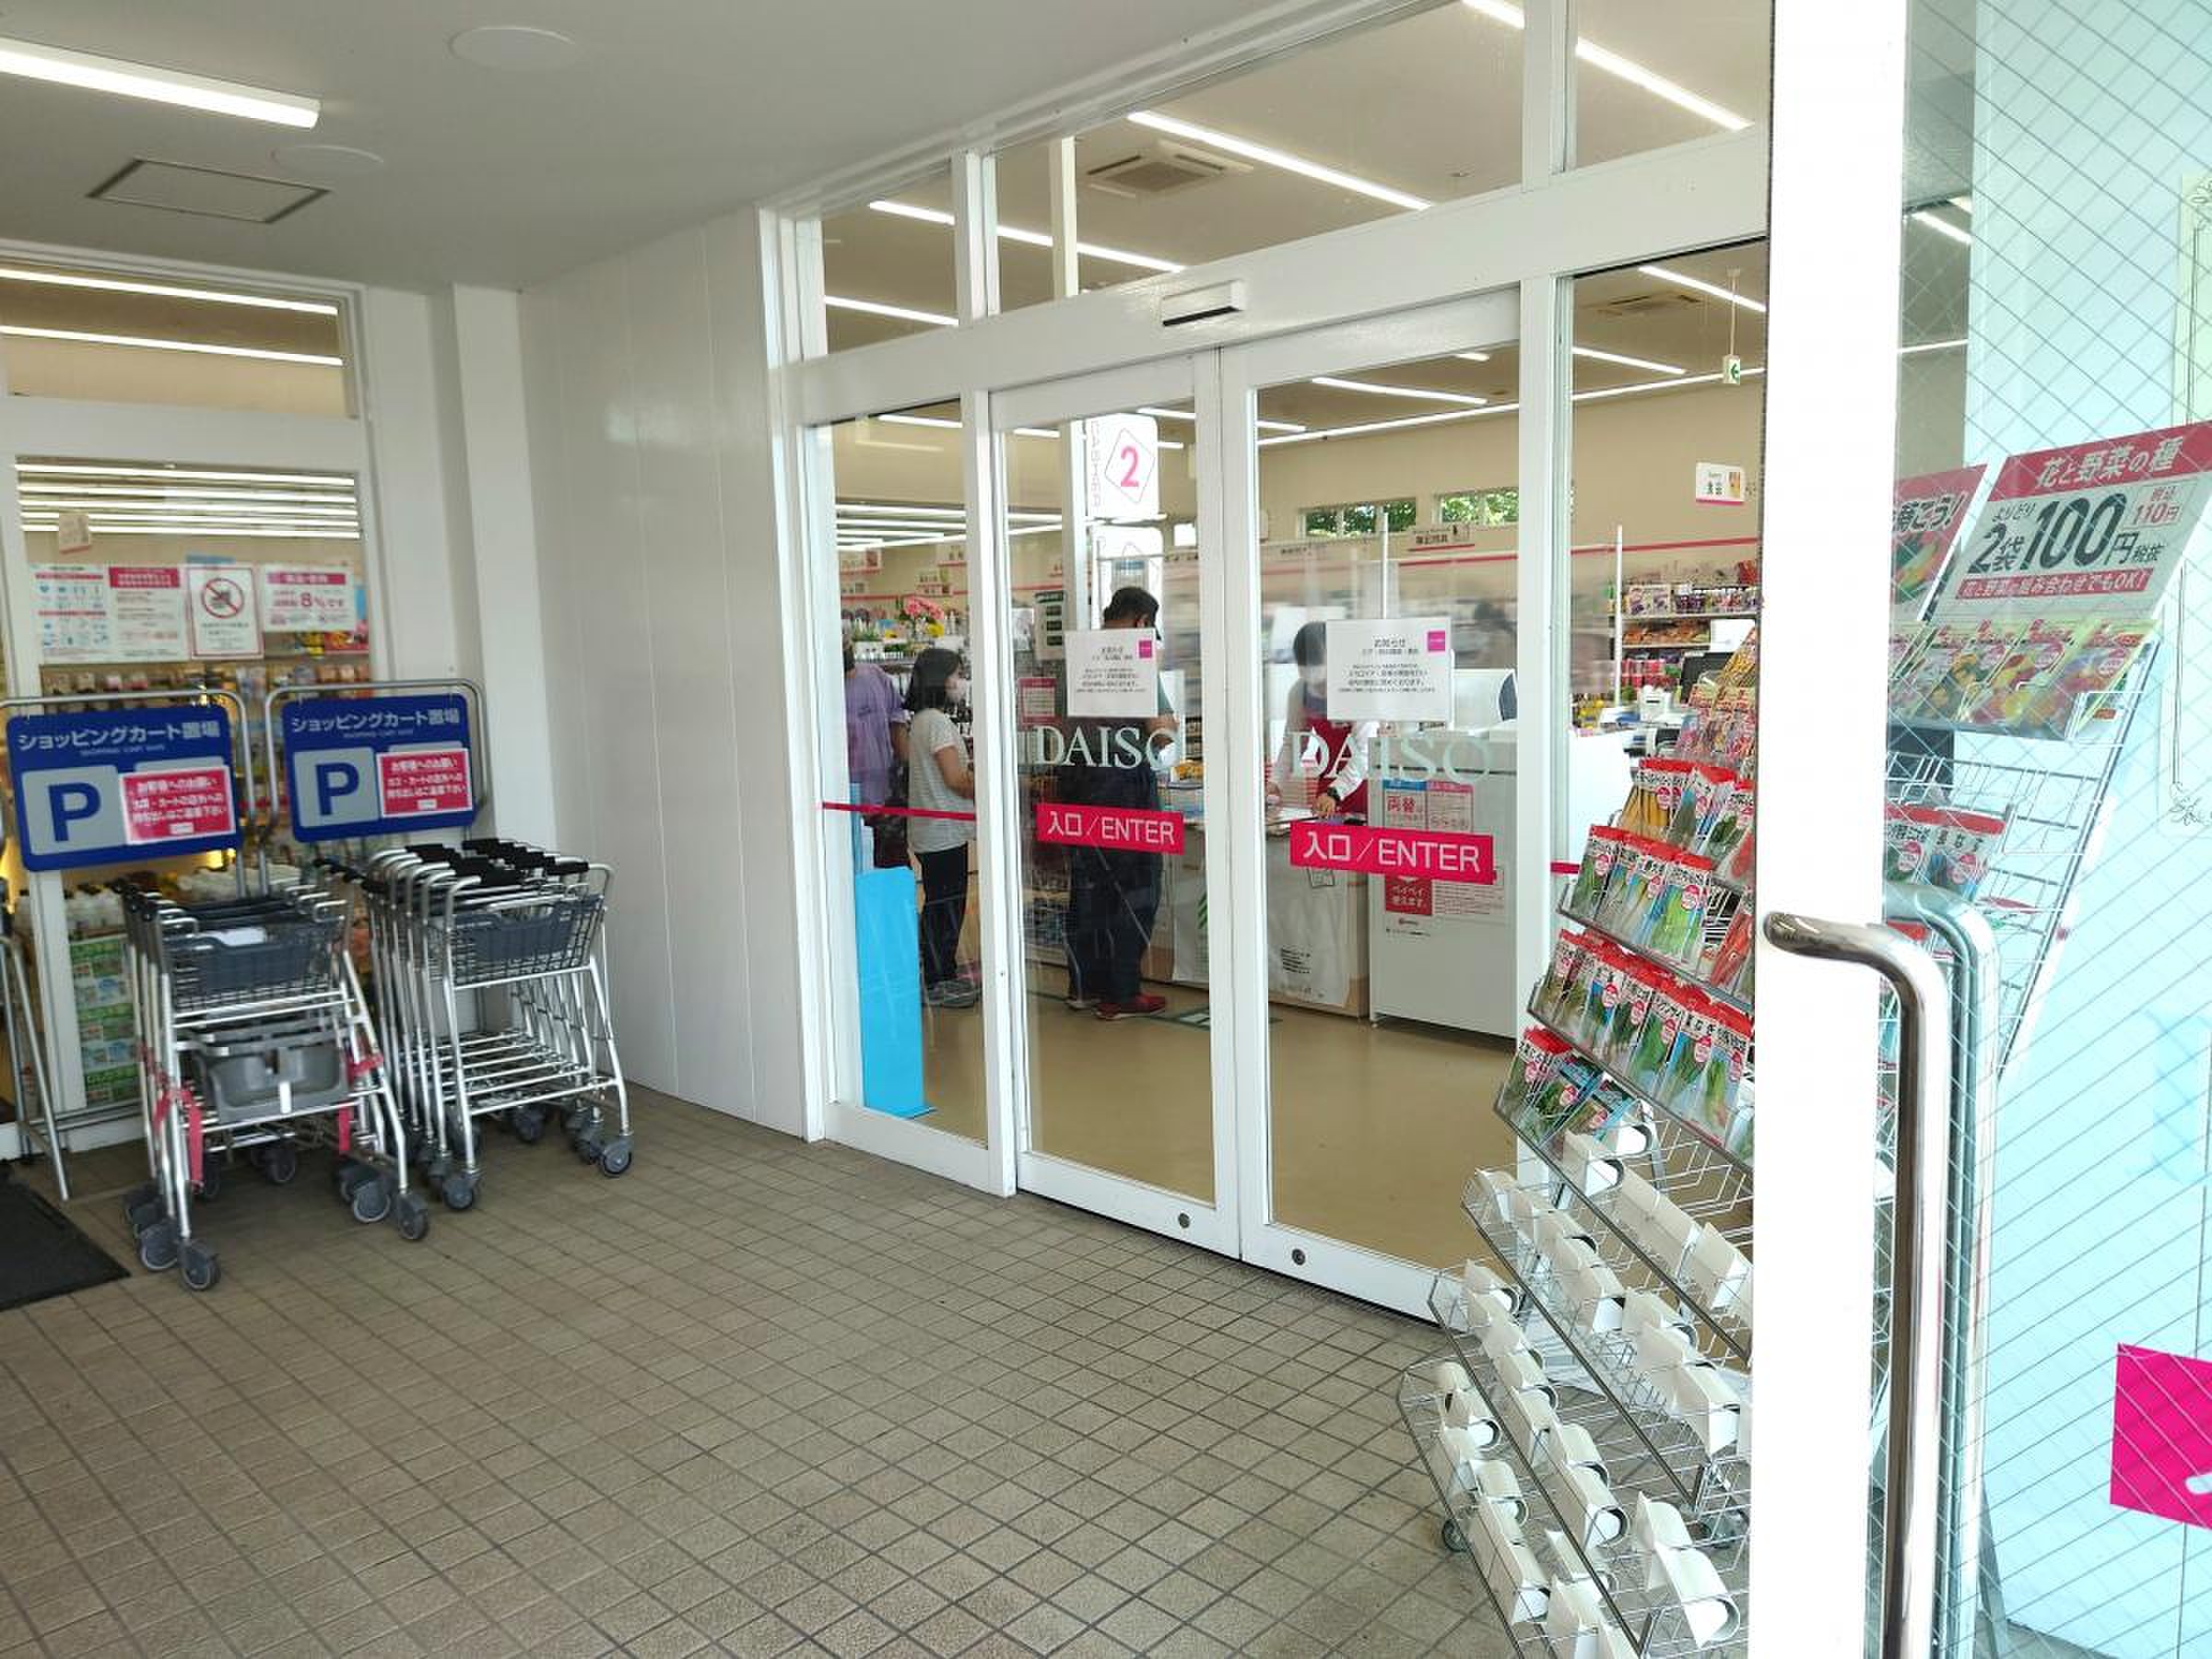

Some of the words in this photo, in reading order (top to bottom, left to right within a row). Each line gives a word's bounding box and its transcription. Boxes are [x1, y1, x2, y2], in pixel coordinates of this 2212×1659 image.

[1120, 445, 1140, 488] 2
[2035, 436, 2183, 488] 花と野菜の種
[2019, 492, 2139, 571] 100円
[18, 721, 220, 751] ショッピングカート置場
[291, 708, 459, 733] ショッピングカート置場
[1032, 724, 1181, 771] DAISO
[1292, 730, 1491, 783] DAISO
[49, 781, 100, 841] P
[315, 761, 359, 816] P
